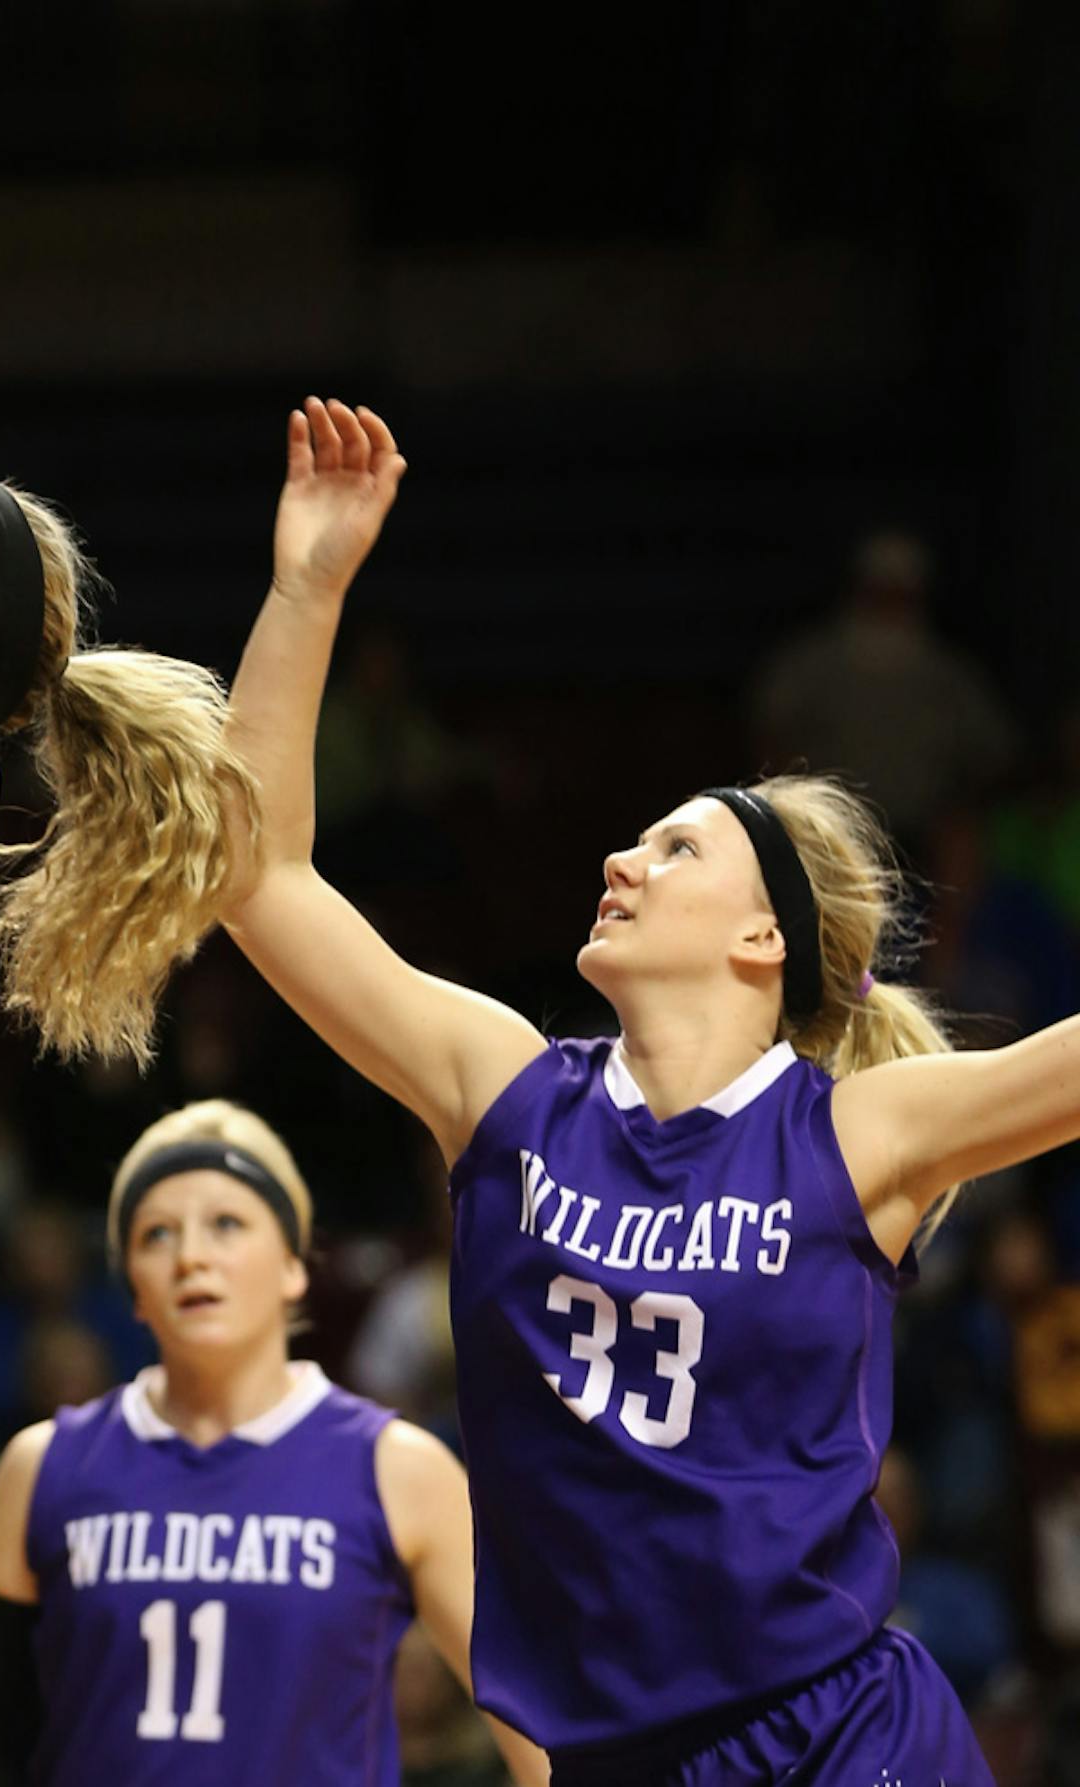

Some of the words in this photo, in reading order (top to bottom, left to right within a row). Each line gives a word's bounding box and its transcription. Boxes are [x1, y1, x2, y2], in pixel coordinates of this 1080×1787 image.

[519, 1148, 793, 1275] WILDCATS
[541, 1273, 705, 1450] 33
[64, 1511, 336, 1589] WILDCATS
[136, 1598, 226, 1742] 11
